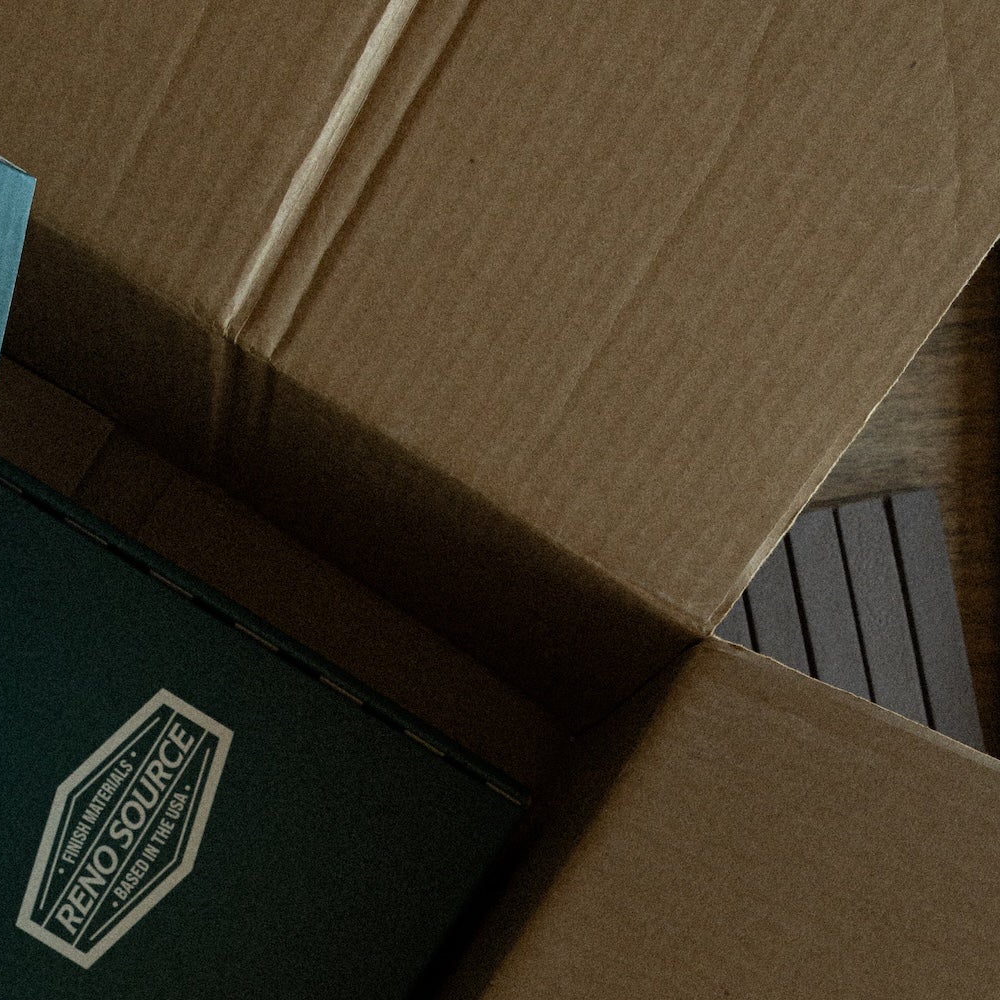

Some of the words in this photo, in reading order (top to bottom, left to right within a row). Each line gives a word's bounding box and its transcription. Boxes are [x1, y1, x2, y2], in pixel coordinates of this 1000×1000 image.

[62, 821, 92, 865] FINISH
[81, 759, 134, 826] MATERIALS
[164, 792, 189, 822] USA
[54, 844, 119, 936] RENO
[109, 722, 196, 849] SOURCE
[151, 821, 176, 846] THE
[142, 843, 161, 862] IN
[113, 858, 150, 902] BASED
